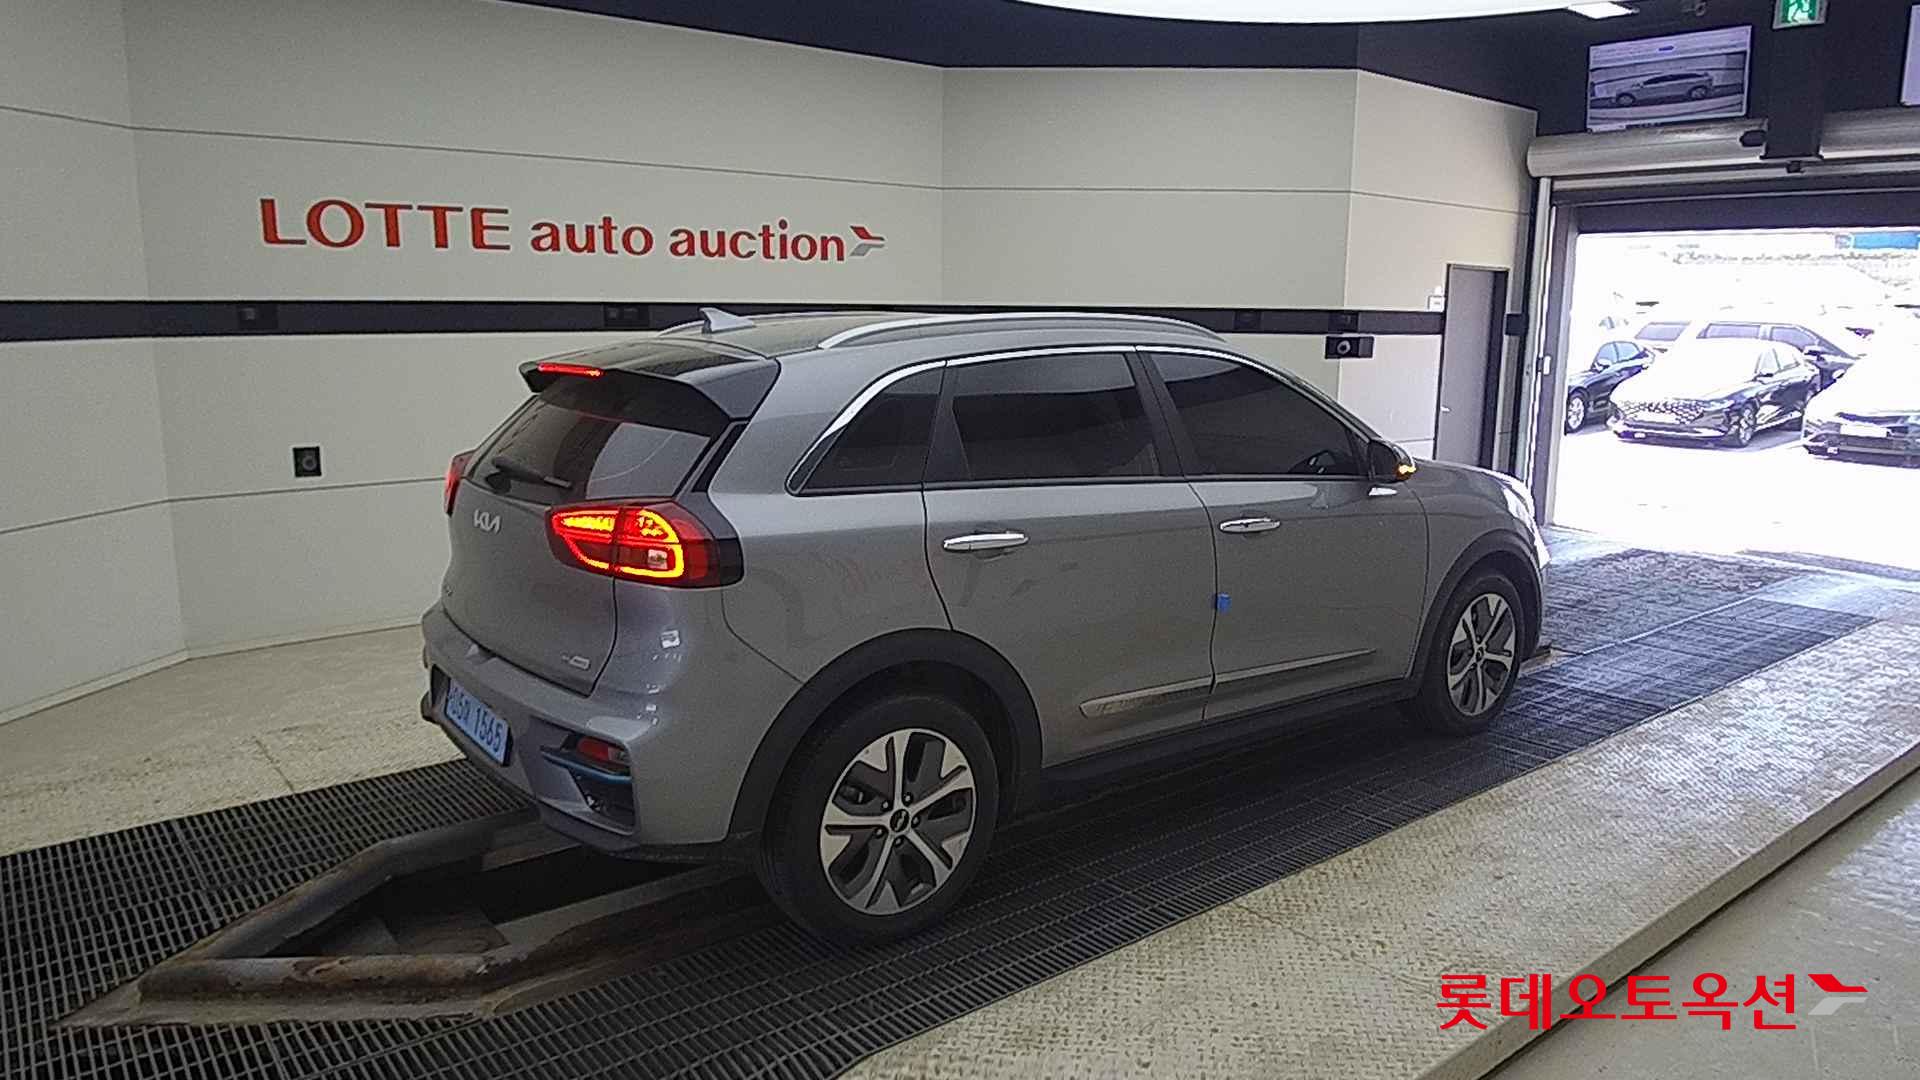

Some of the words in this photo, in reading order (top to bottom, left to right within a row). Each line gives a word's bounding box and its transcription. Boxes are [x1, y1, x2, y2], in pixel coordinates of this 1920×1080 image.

[260, 198, 510, 251] LOTTE
[530, 216, 655, 257] auto
[669, 219, 847, 262] auction
